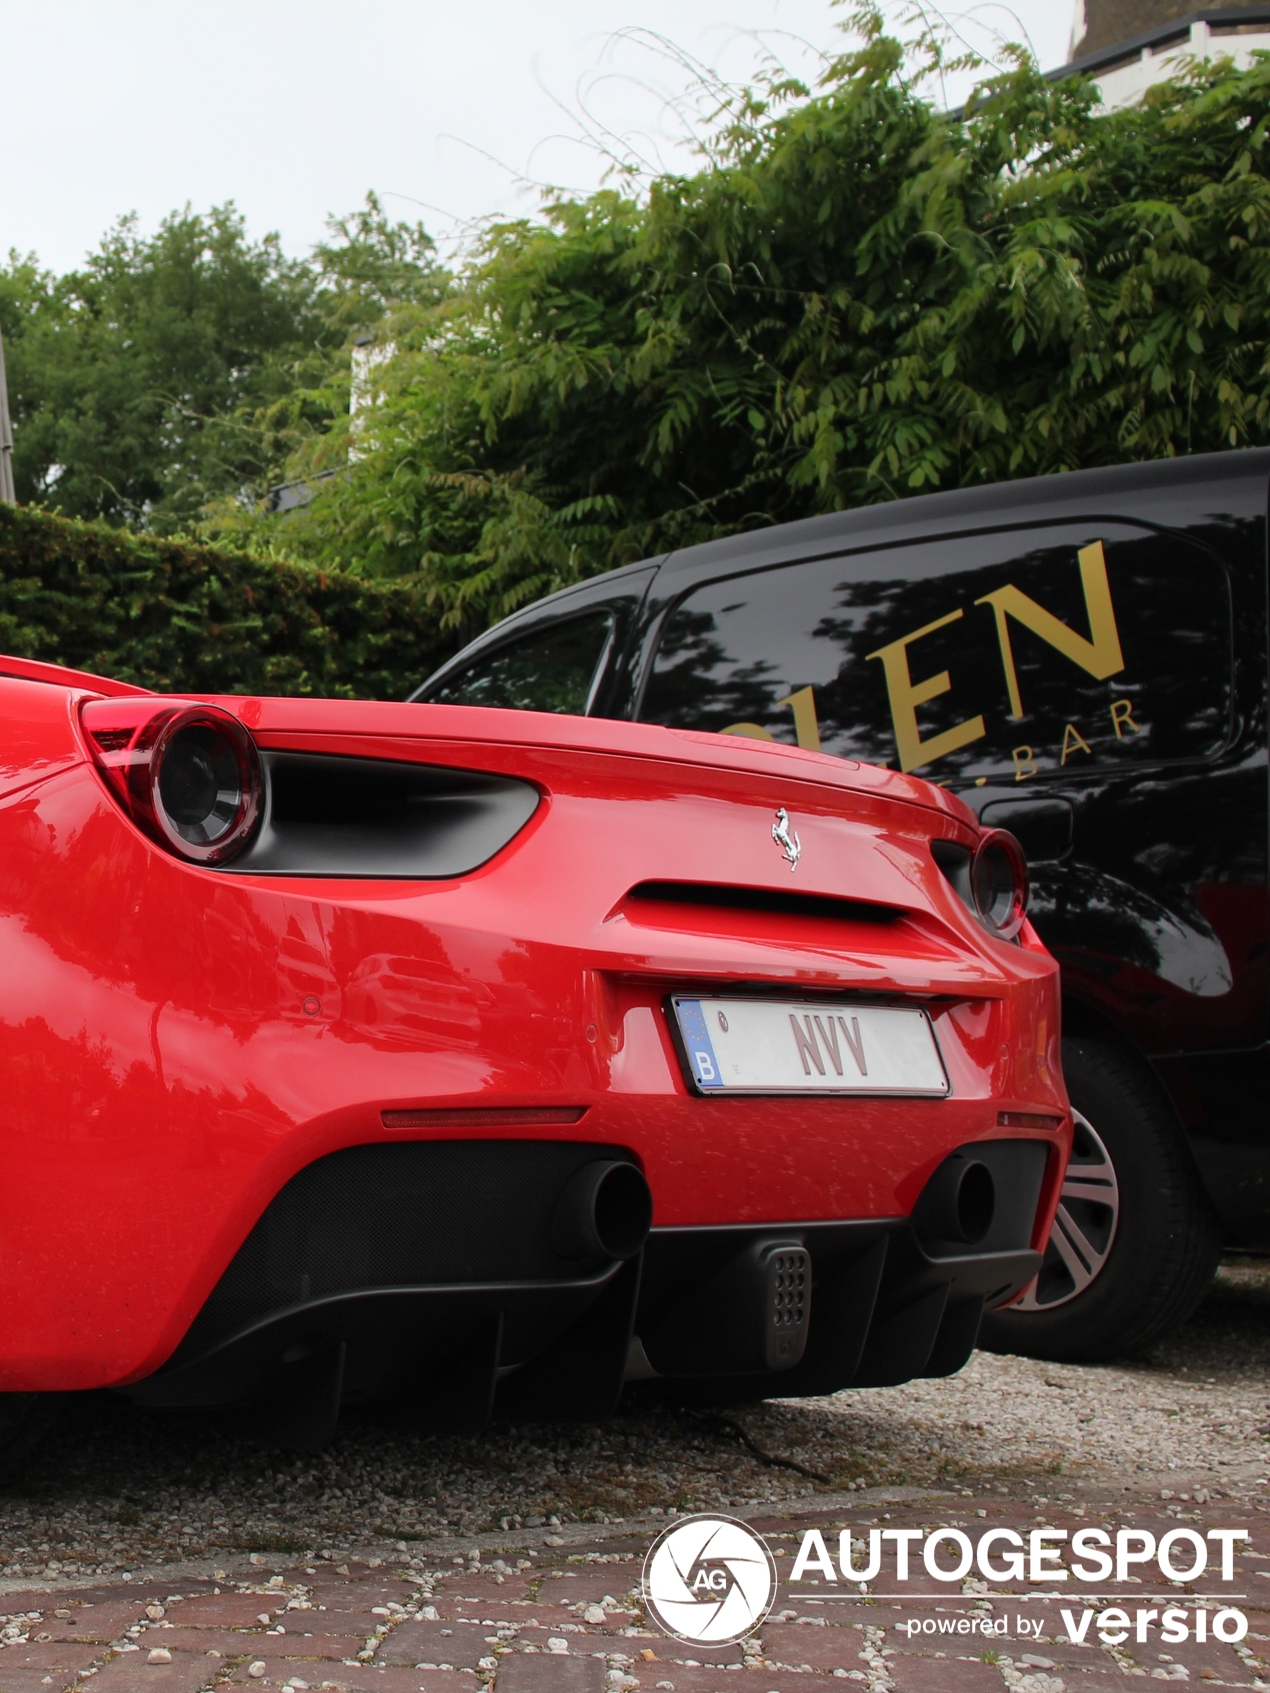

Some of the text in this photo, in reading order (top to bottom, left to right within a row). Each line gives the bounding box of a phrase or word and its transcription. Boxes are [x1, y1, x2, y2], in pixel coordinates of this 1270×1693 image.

[1012, 699, 1140, 782] BAR
[694, 1051, 715, 1080] B
[788, 1014, 868, 1076] NVV
